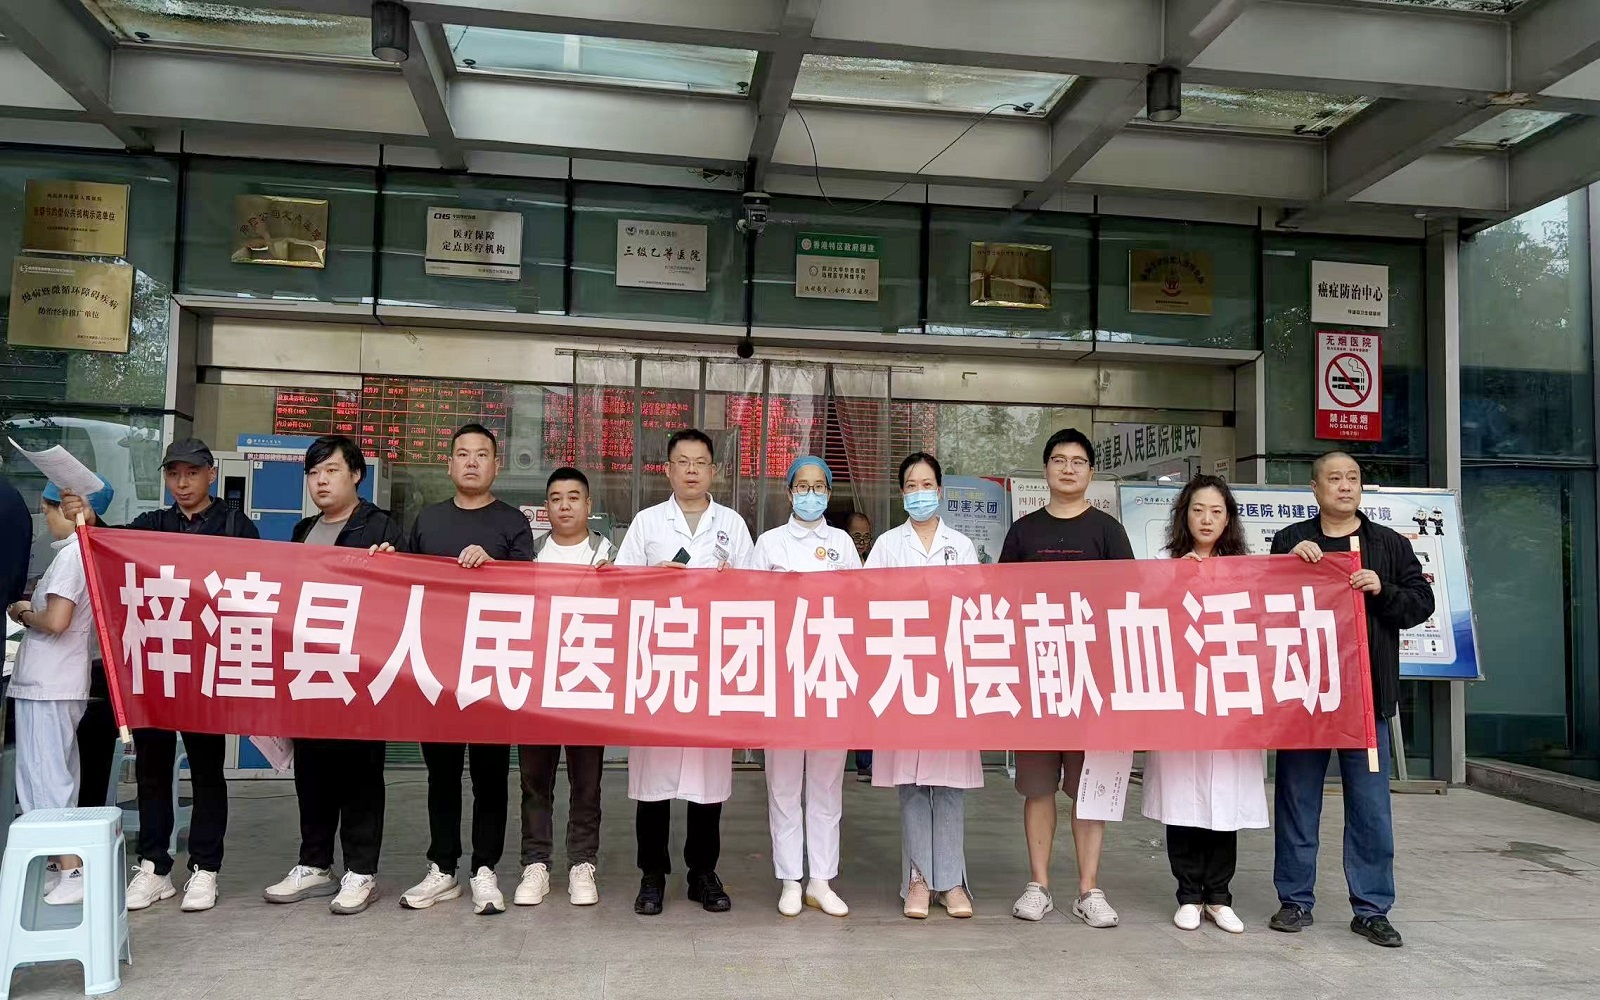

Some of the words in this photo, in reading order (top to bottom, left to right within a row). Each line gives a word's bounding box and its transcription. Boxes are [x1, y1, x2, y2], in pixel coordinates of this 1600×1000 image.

[453, 229, 495, 241] 医疗保障
[442, 241, 506, 255] 定点医疗机构
[623, 245, 701, 262] 三级乙等医院
[813, 240, 876, 253] 香港特区政府援建
[1317, 281, 1383, 303] 癌症防治中心
[1326, 335, 1372, 348] 无烟医院
[1329, 413, 1368, 425] 禁止吸烟
[947, 499, 998, 514] 四害天团
[119, 562, 1342, 719] 梓潼县人民医院团体无偿献血活动
